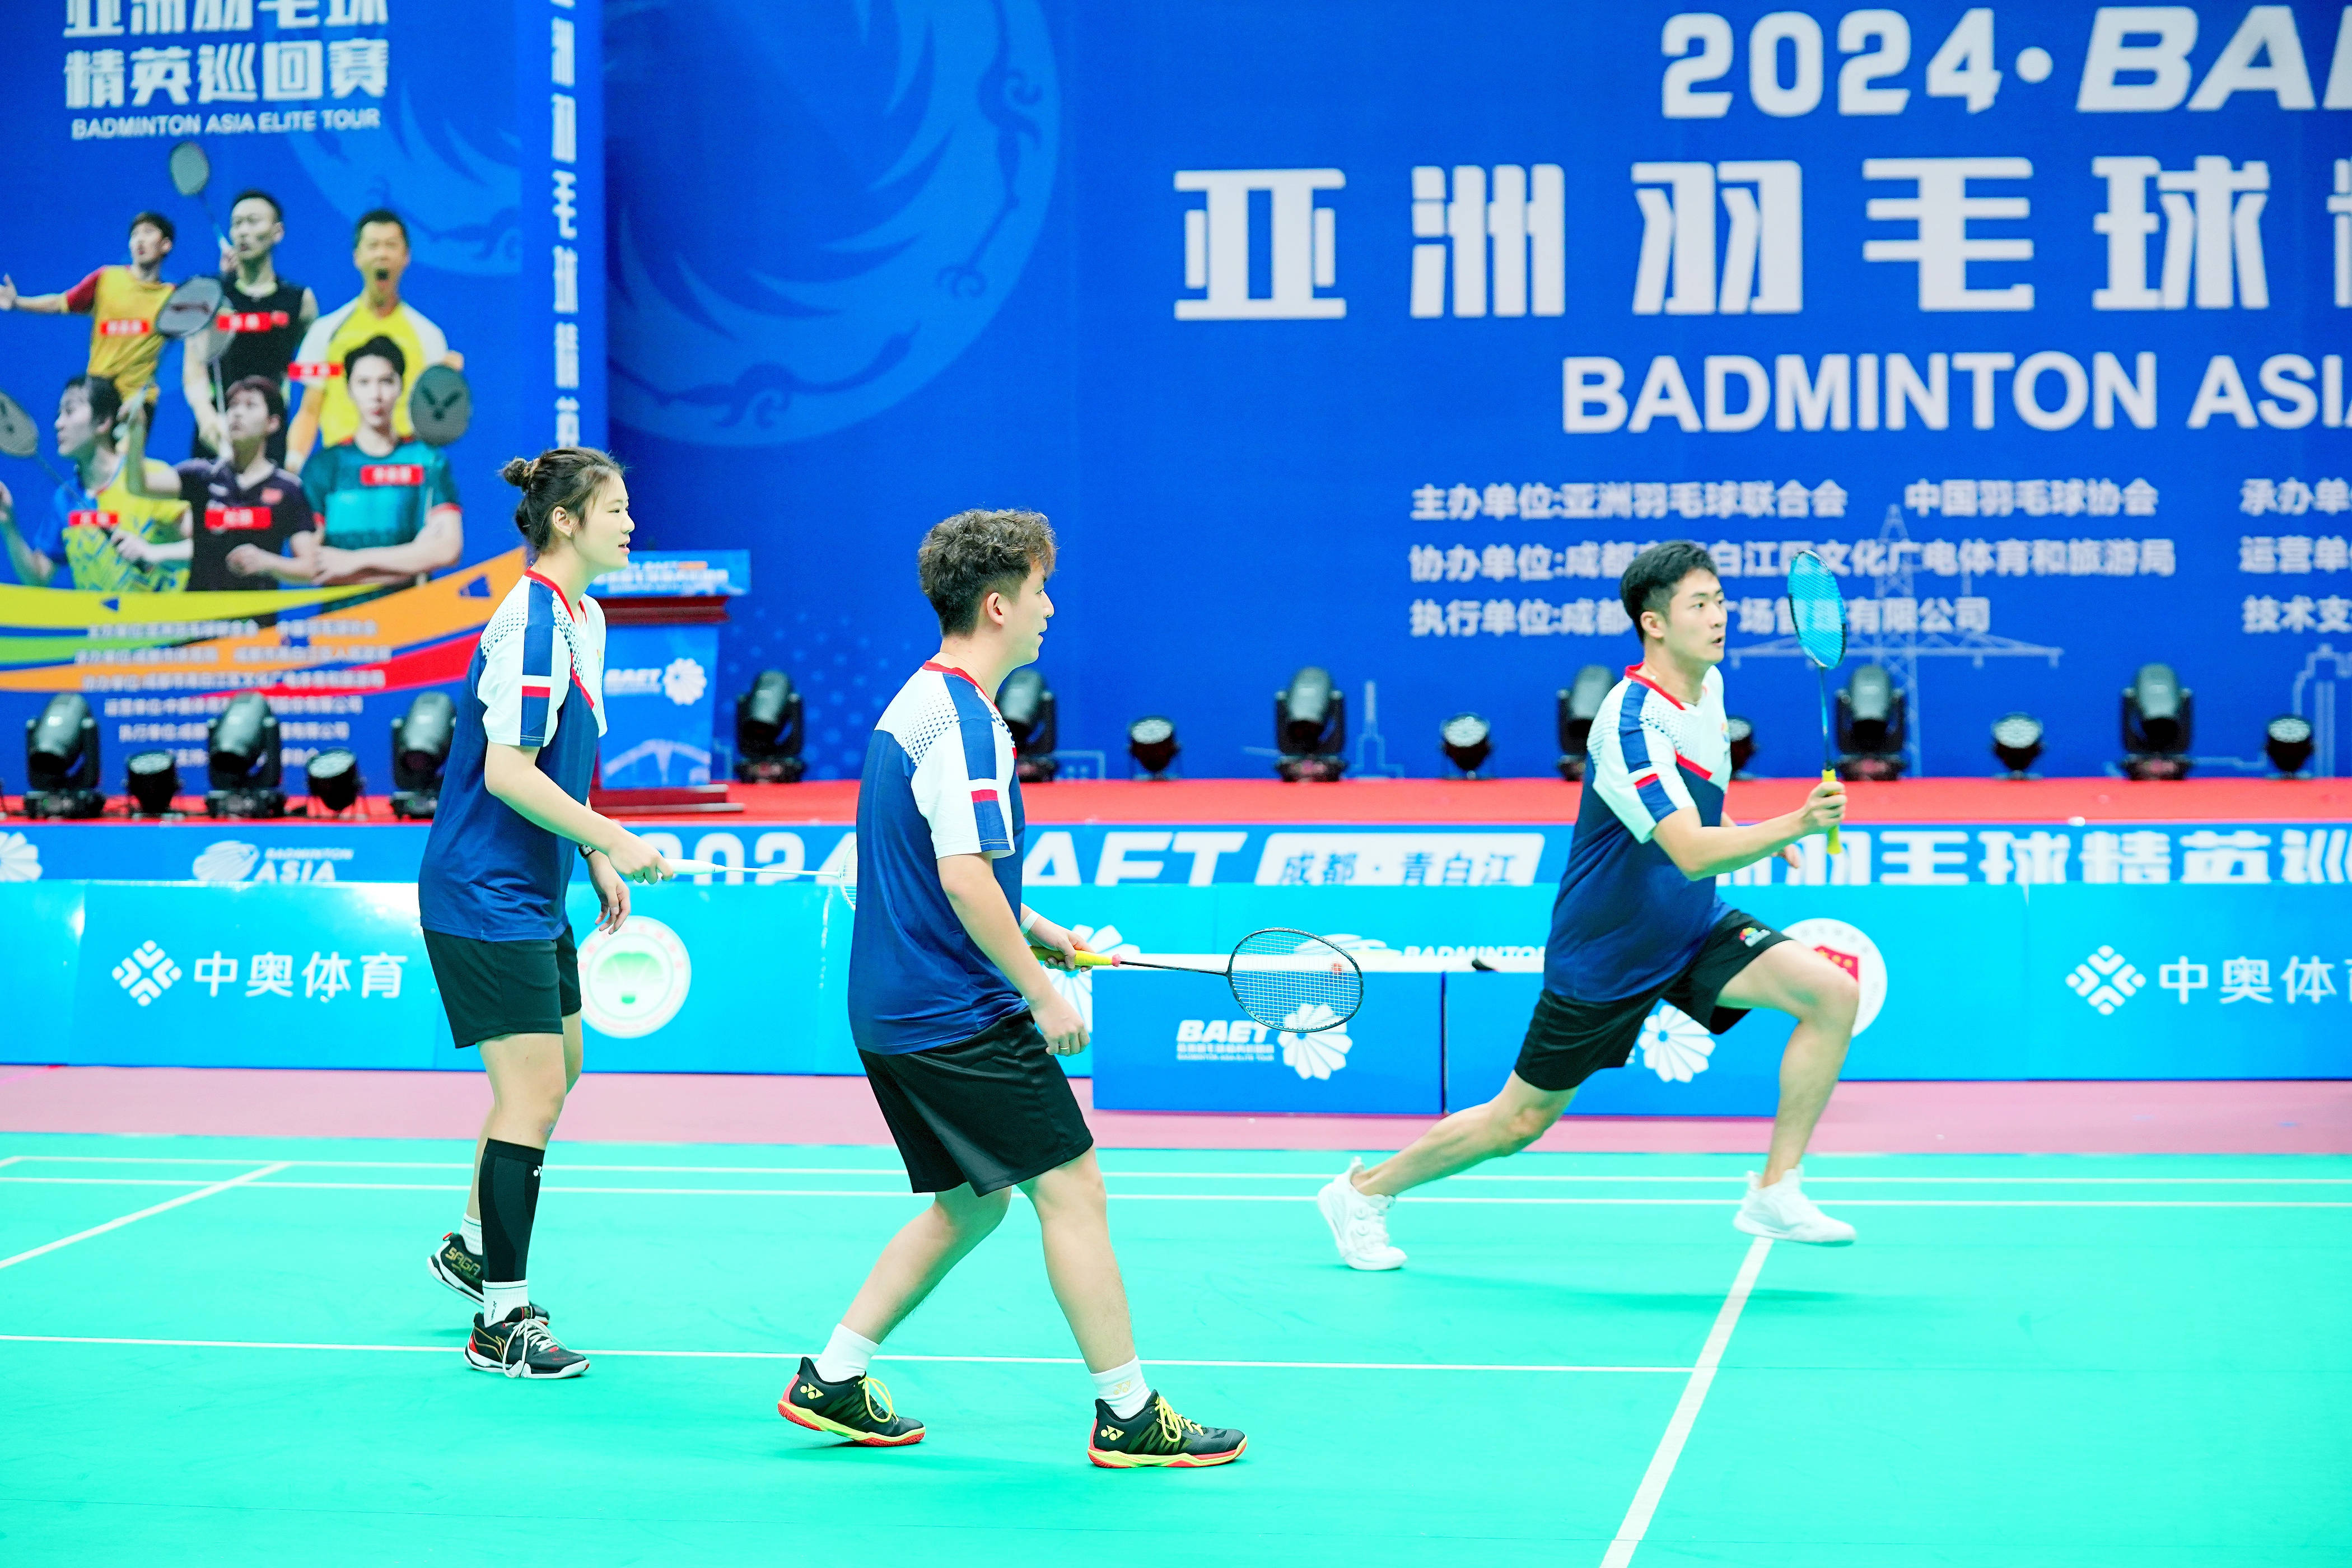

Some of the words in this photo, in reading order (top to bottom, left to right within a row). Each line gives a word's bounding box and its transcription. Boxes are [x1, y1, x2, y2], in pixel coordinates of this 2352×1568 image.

[64, 39, 389, 108] 精英巡回赛
[72, 115, 201, 139] BADMINTON
[205, 114, 255, 134] ASIA
[258, 110, 316, 132] ELITE
[321, 108, 381, 130] TOUR
[1174, 156, 2352, 320] 亚洲羽毛球
[1562, 351, 2157, 434] BADMINTON
[2187, 354, 2352, 430] ASI
[1411, 479, 1847, 521] 主办单位:亚洲羽毛球联合会
[1905, 478, 2158, 516] 中国羽毛球协会
[2241, 478, 2352, 516] 承办单
[1409, 538, 2176, 582] 协办单位:成都白江区文化广电体育和旅游局
[2240, 535, 2352, 575] 运营单
[2242, 595, 2352, 633] 技术支
[254, 860, 337, 883] ASIA
[194, 951, 408, 998] 中奥体育
[2159, 955, 2352, 1004] 中奥体
[1177, 1020, 1271, 1043] BAET
